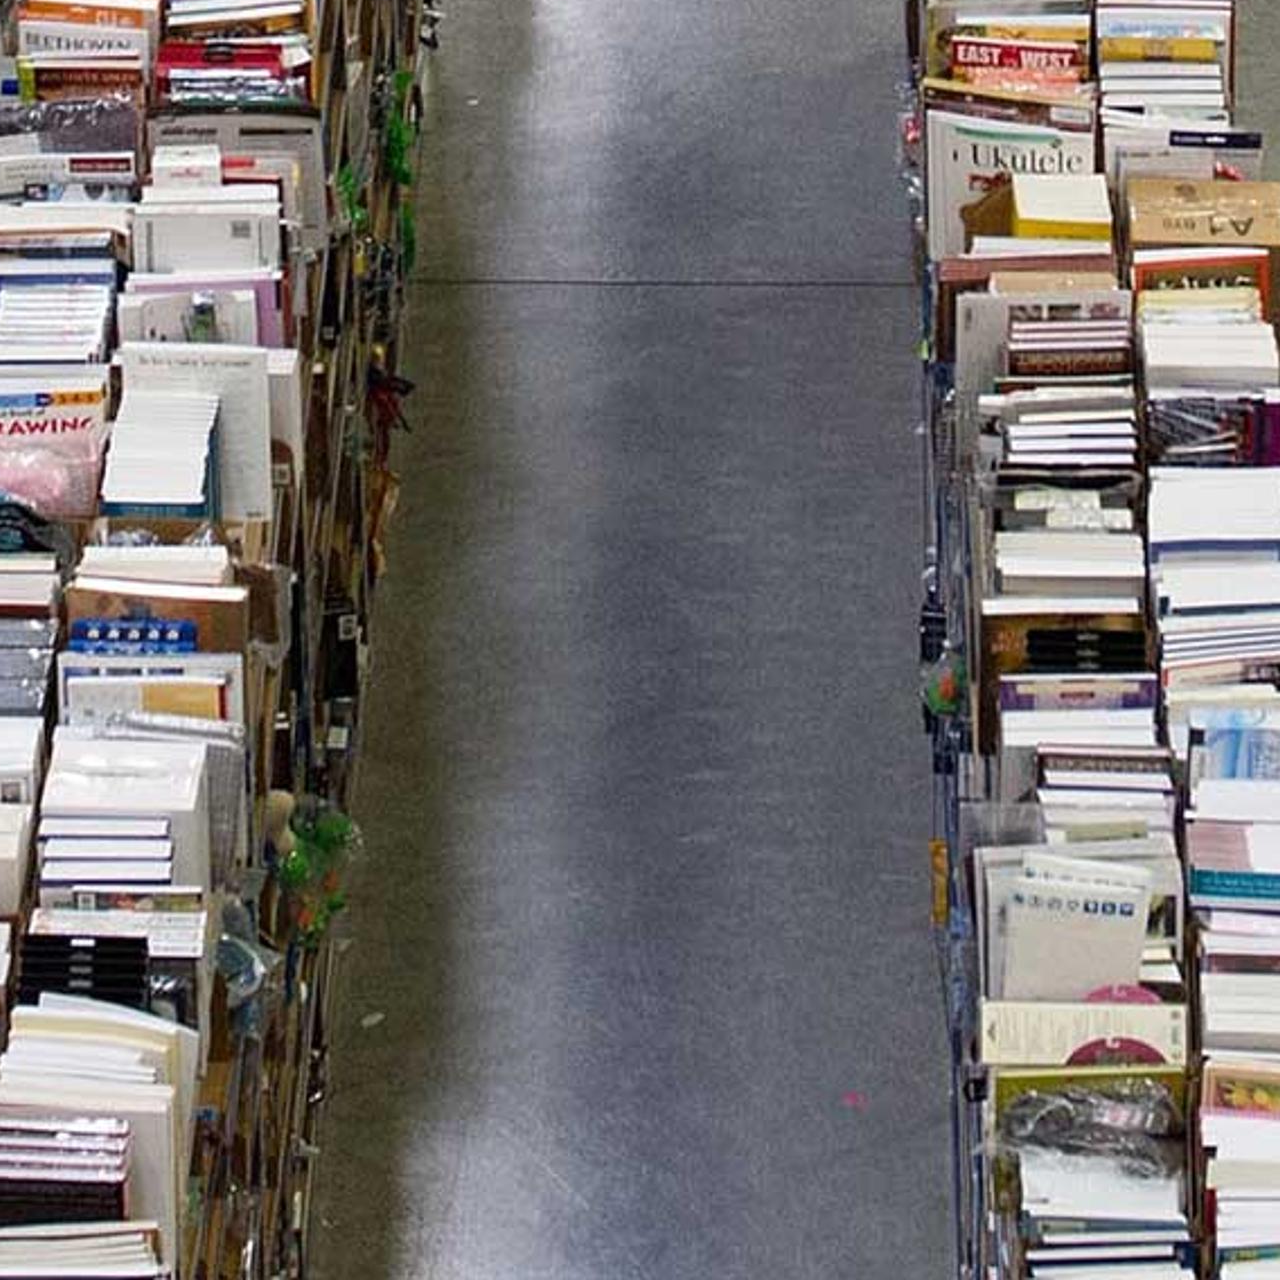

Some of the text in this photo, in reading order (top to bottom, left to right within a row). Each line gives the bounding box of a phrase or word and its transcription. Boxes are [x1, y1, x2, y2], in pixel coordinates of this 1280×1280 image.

[957, 44, 1075, 70] EAST WEST
[969, 142, 1085, 176] Ukulele
